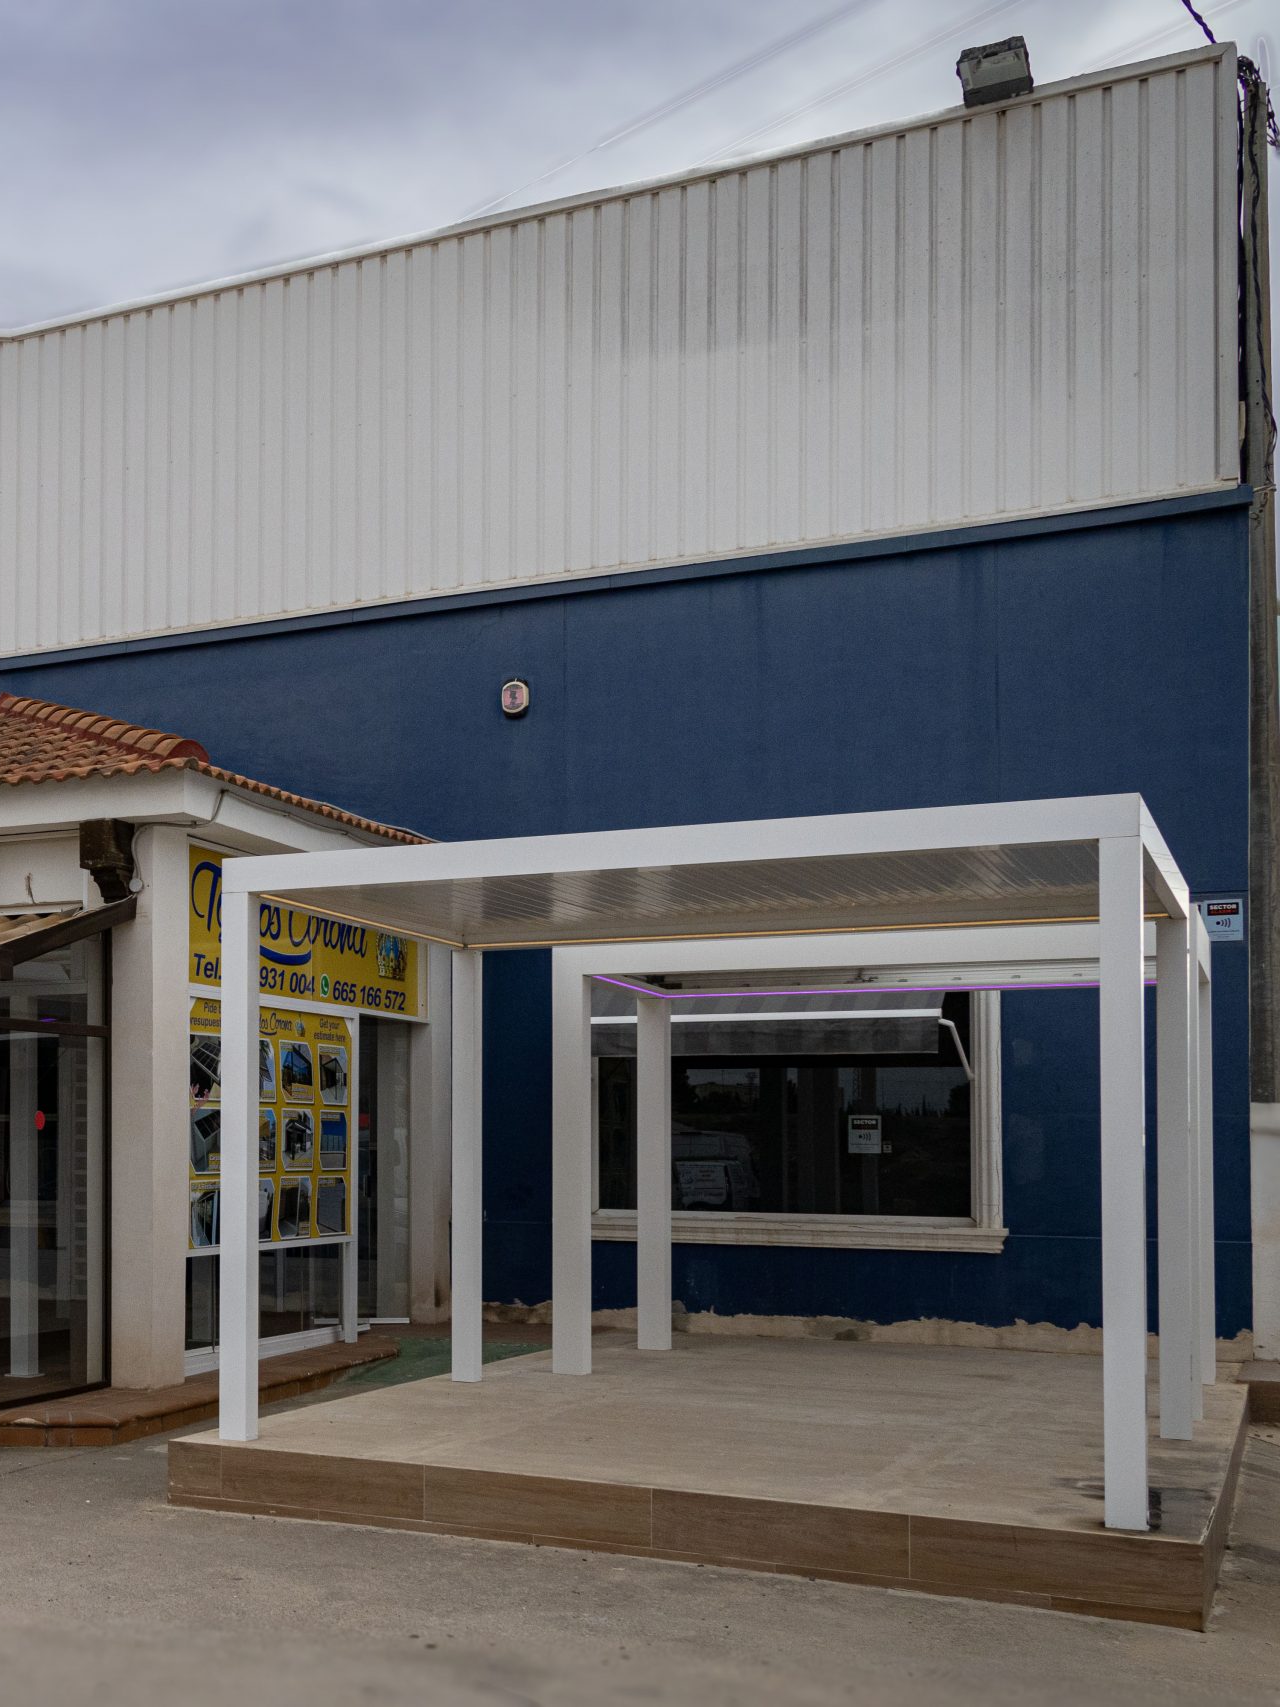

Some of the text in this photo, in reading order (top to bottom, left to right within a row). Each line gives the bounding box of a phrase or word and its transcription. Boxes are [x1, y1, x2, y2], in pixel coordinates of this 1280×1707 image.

[193, 952, 407, 1012] Tel. 931 004 665 166 572
